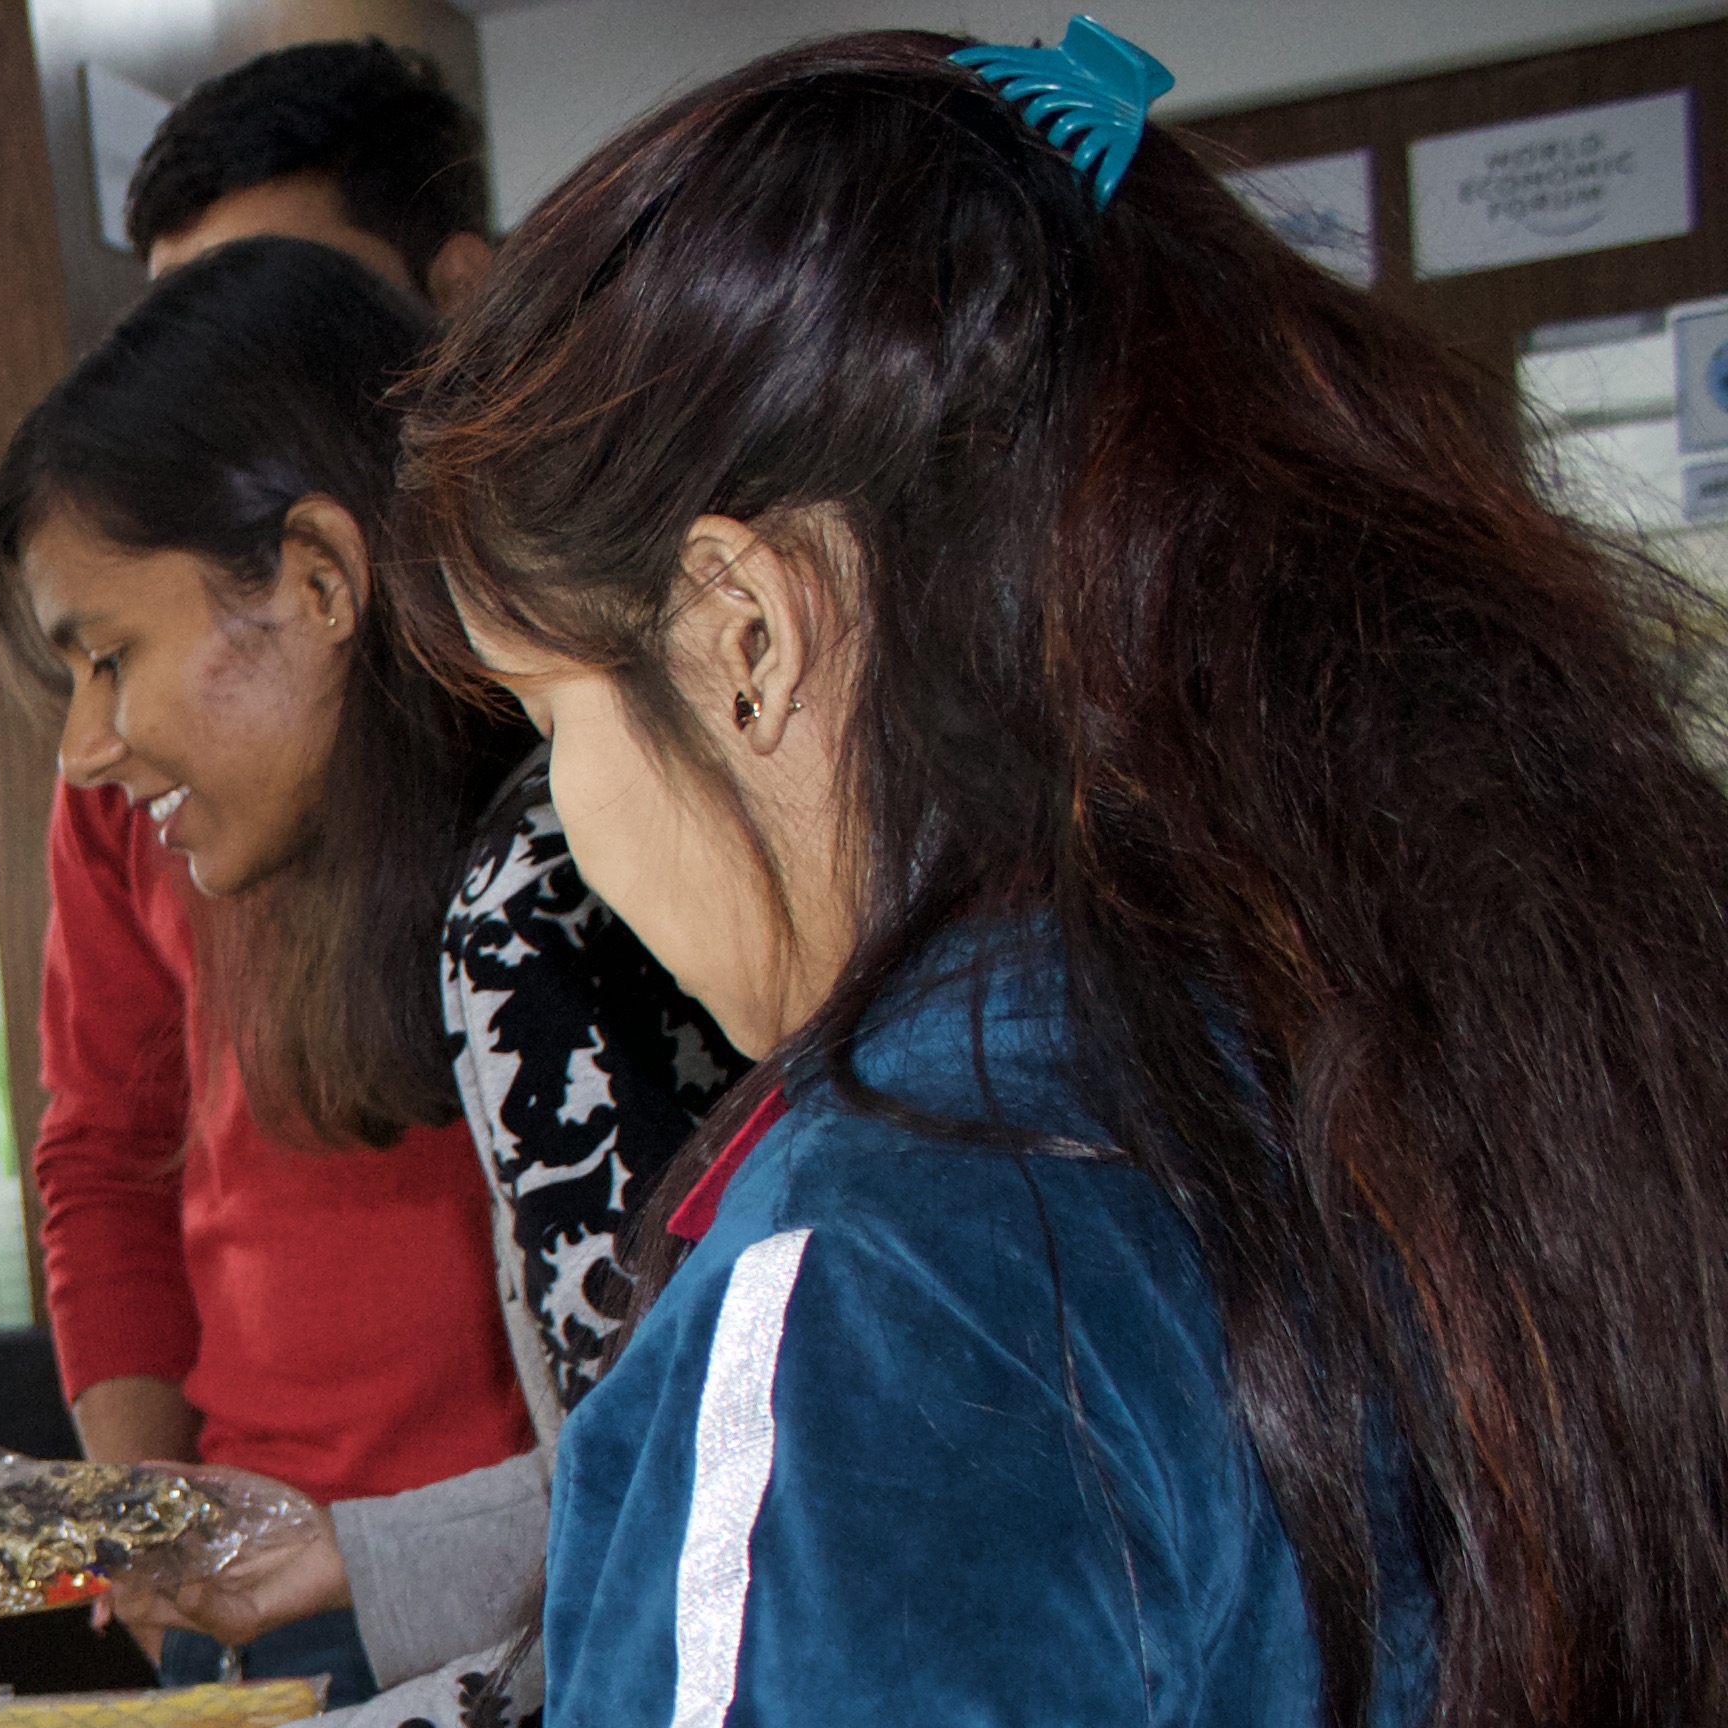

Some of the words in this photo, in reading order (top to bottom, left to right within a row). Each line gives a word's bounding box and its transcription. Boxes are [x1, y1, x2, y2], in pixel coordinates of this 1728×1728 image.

[1486, 133, 1604, 170] WORLD
[1458, 151, 1635, 204] ECONOMIC
[1487, 185, 1604, 223] FORUM
